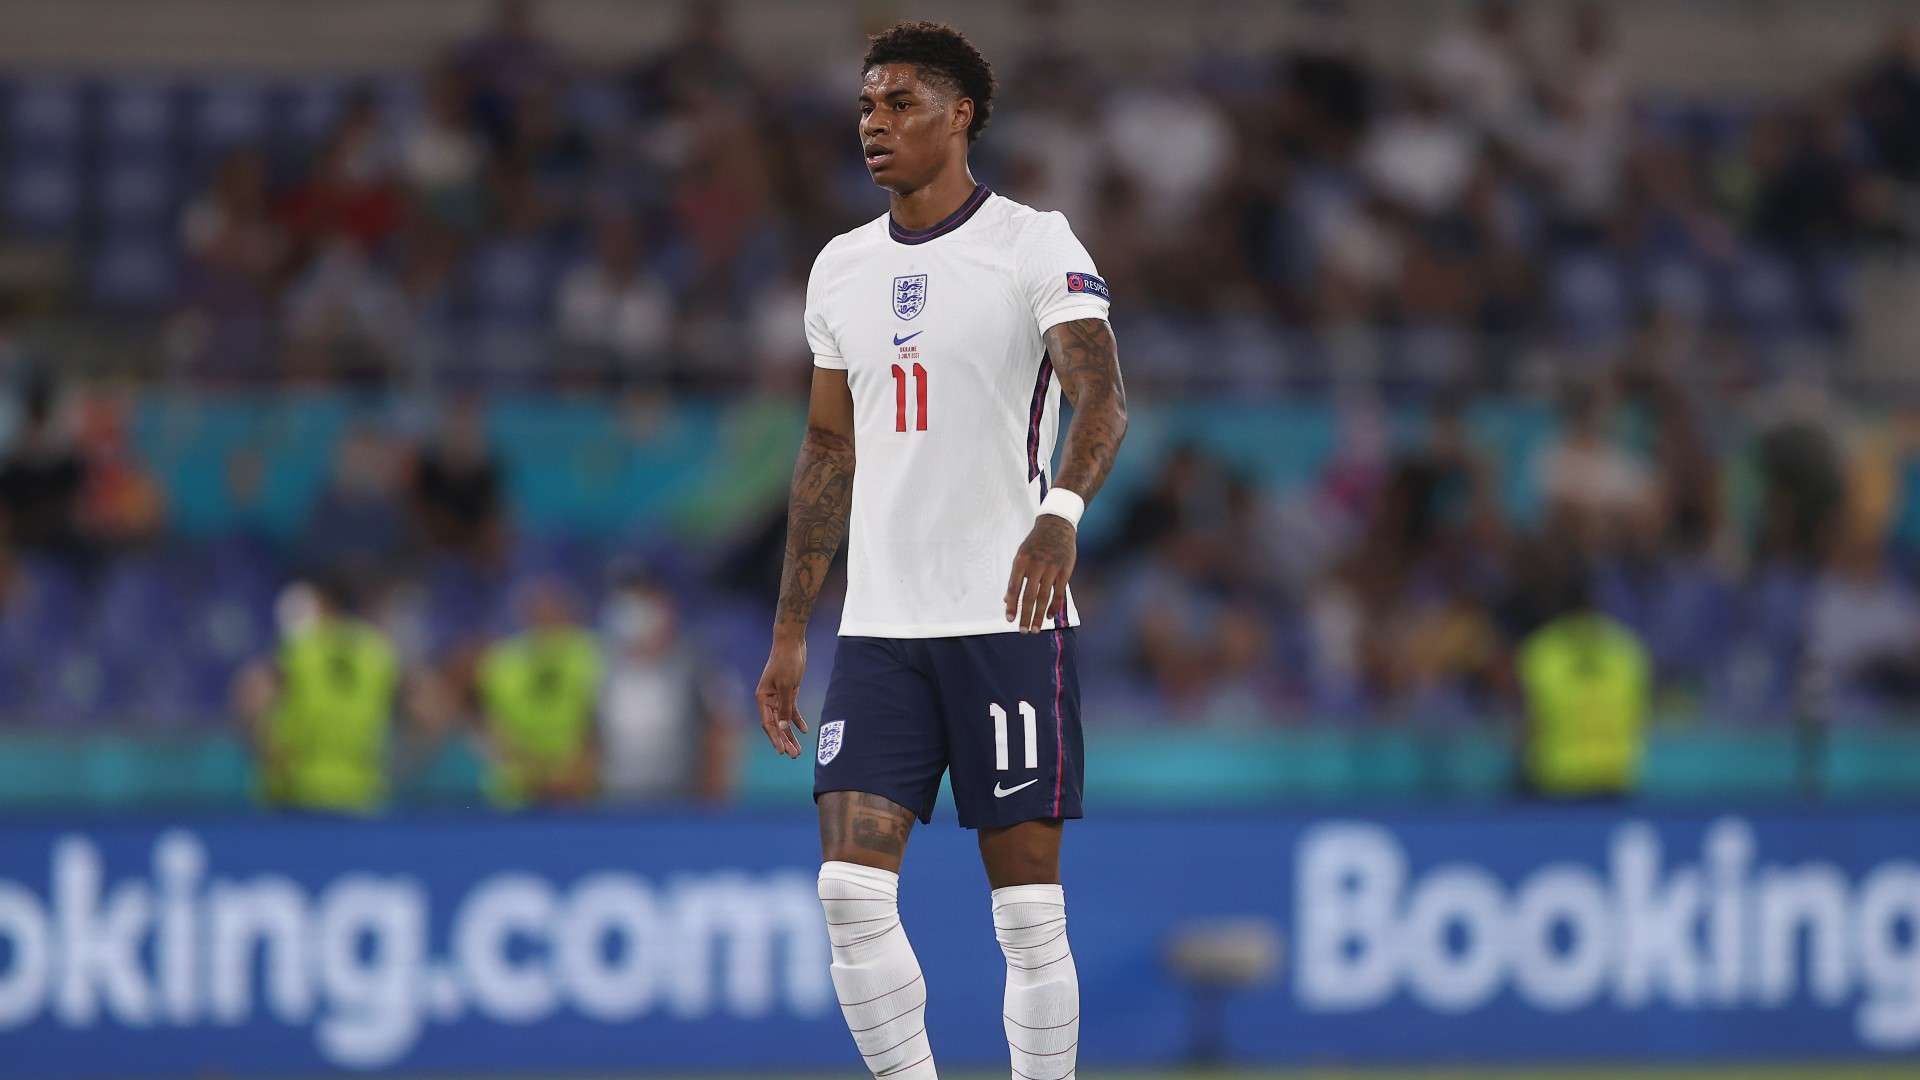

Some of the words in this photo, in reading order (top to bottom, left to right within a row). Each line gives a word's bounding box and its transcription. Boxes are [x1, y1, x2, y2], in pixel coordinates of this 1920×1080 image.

[891, 362, 928, 432] 11
[989, 700, 1038, 770] 11
[1295, 818, 1920, 1048] Booking
